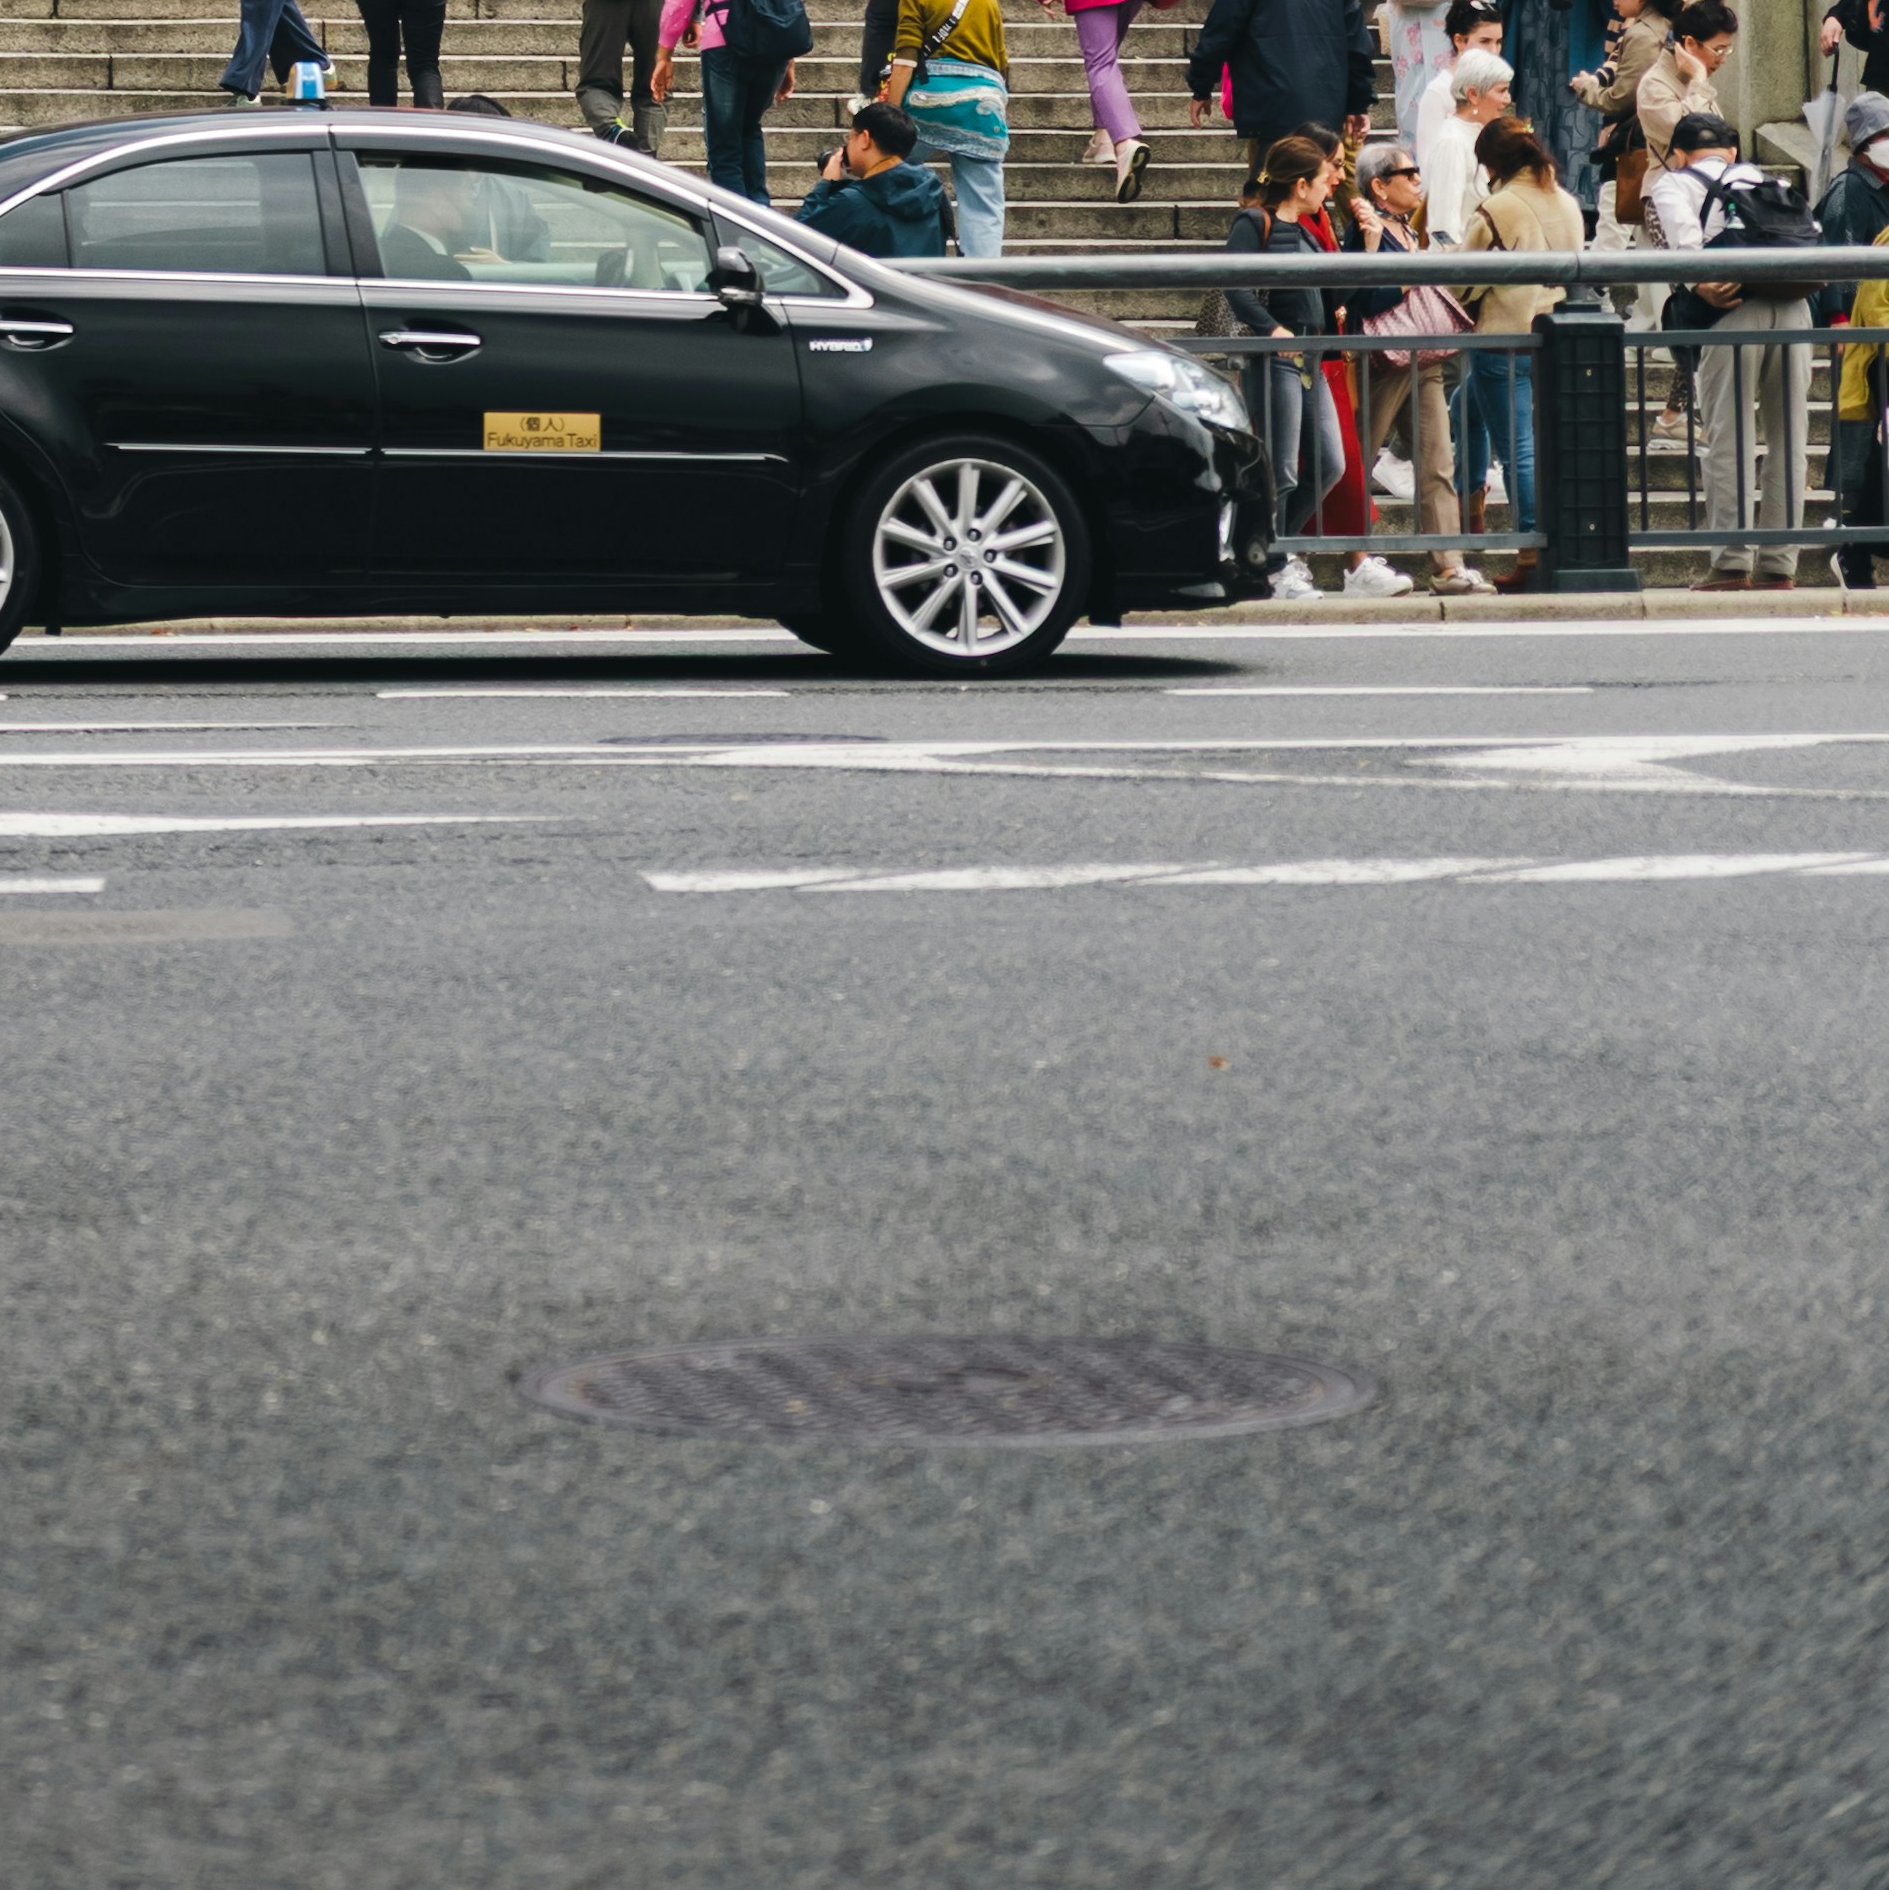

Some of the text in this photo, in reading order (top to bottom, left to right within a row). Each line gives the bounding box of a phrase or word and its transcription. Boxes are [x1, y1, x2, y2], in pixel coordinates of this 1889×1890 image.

[809, 340, 862, 352] HYBRID
[487, 432, 598, 449] Fukuyama Taxi
